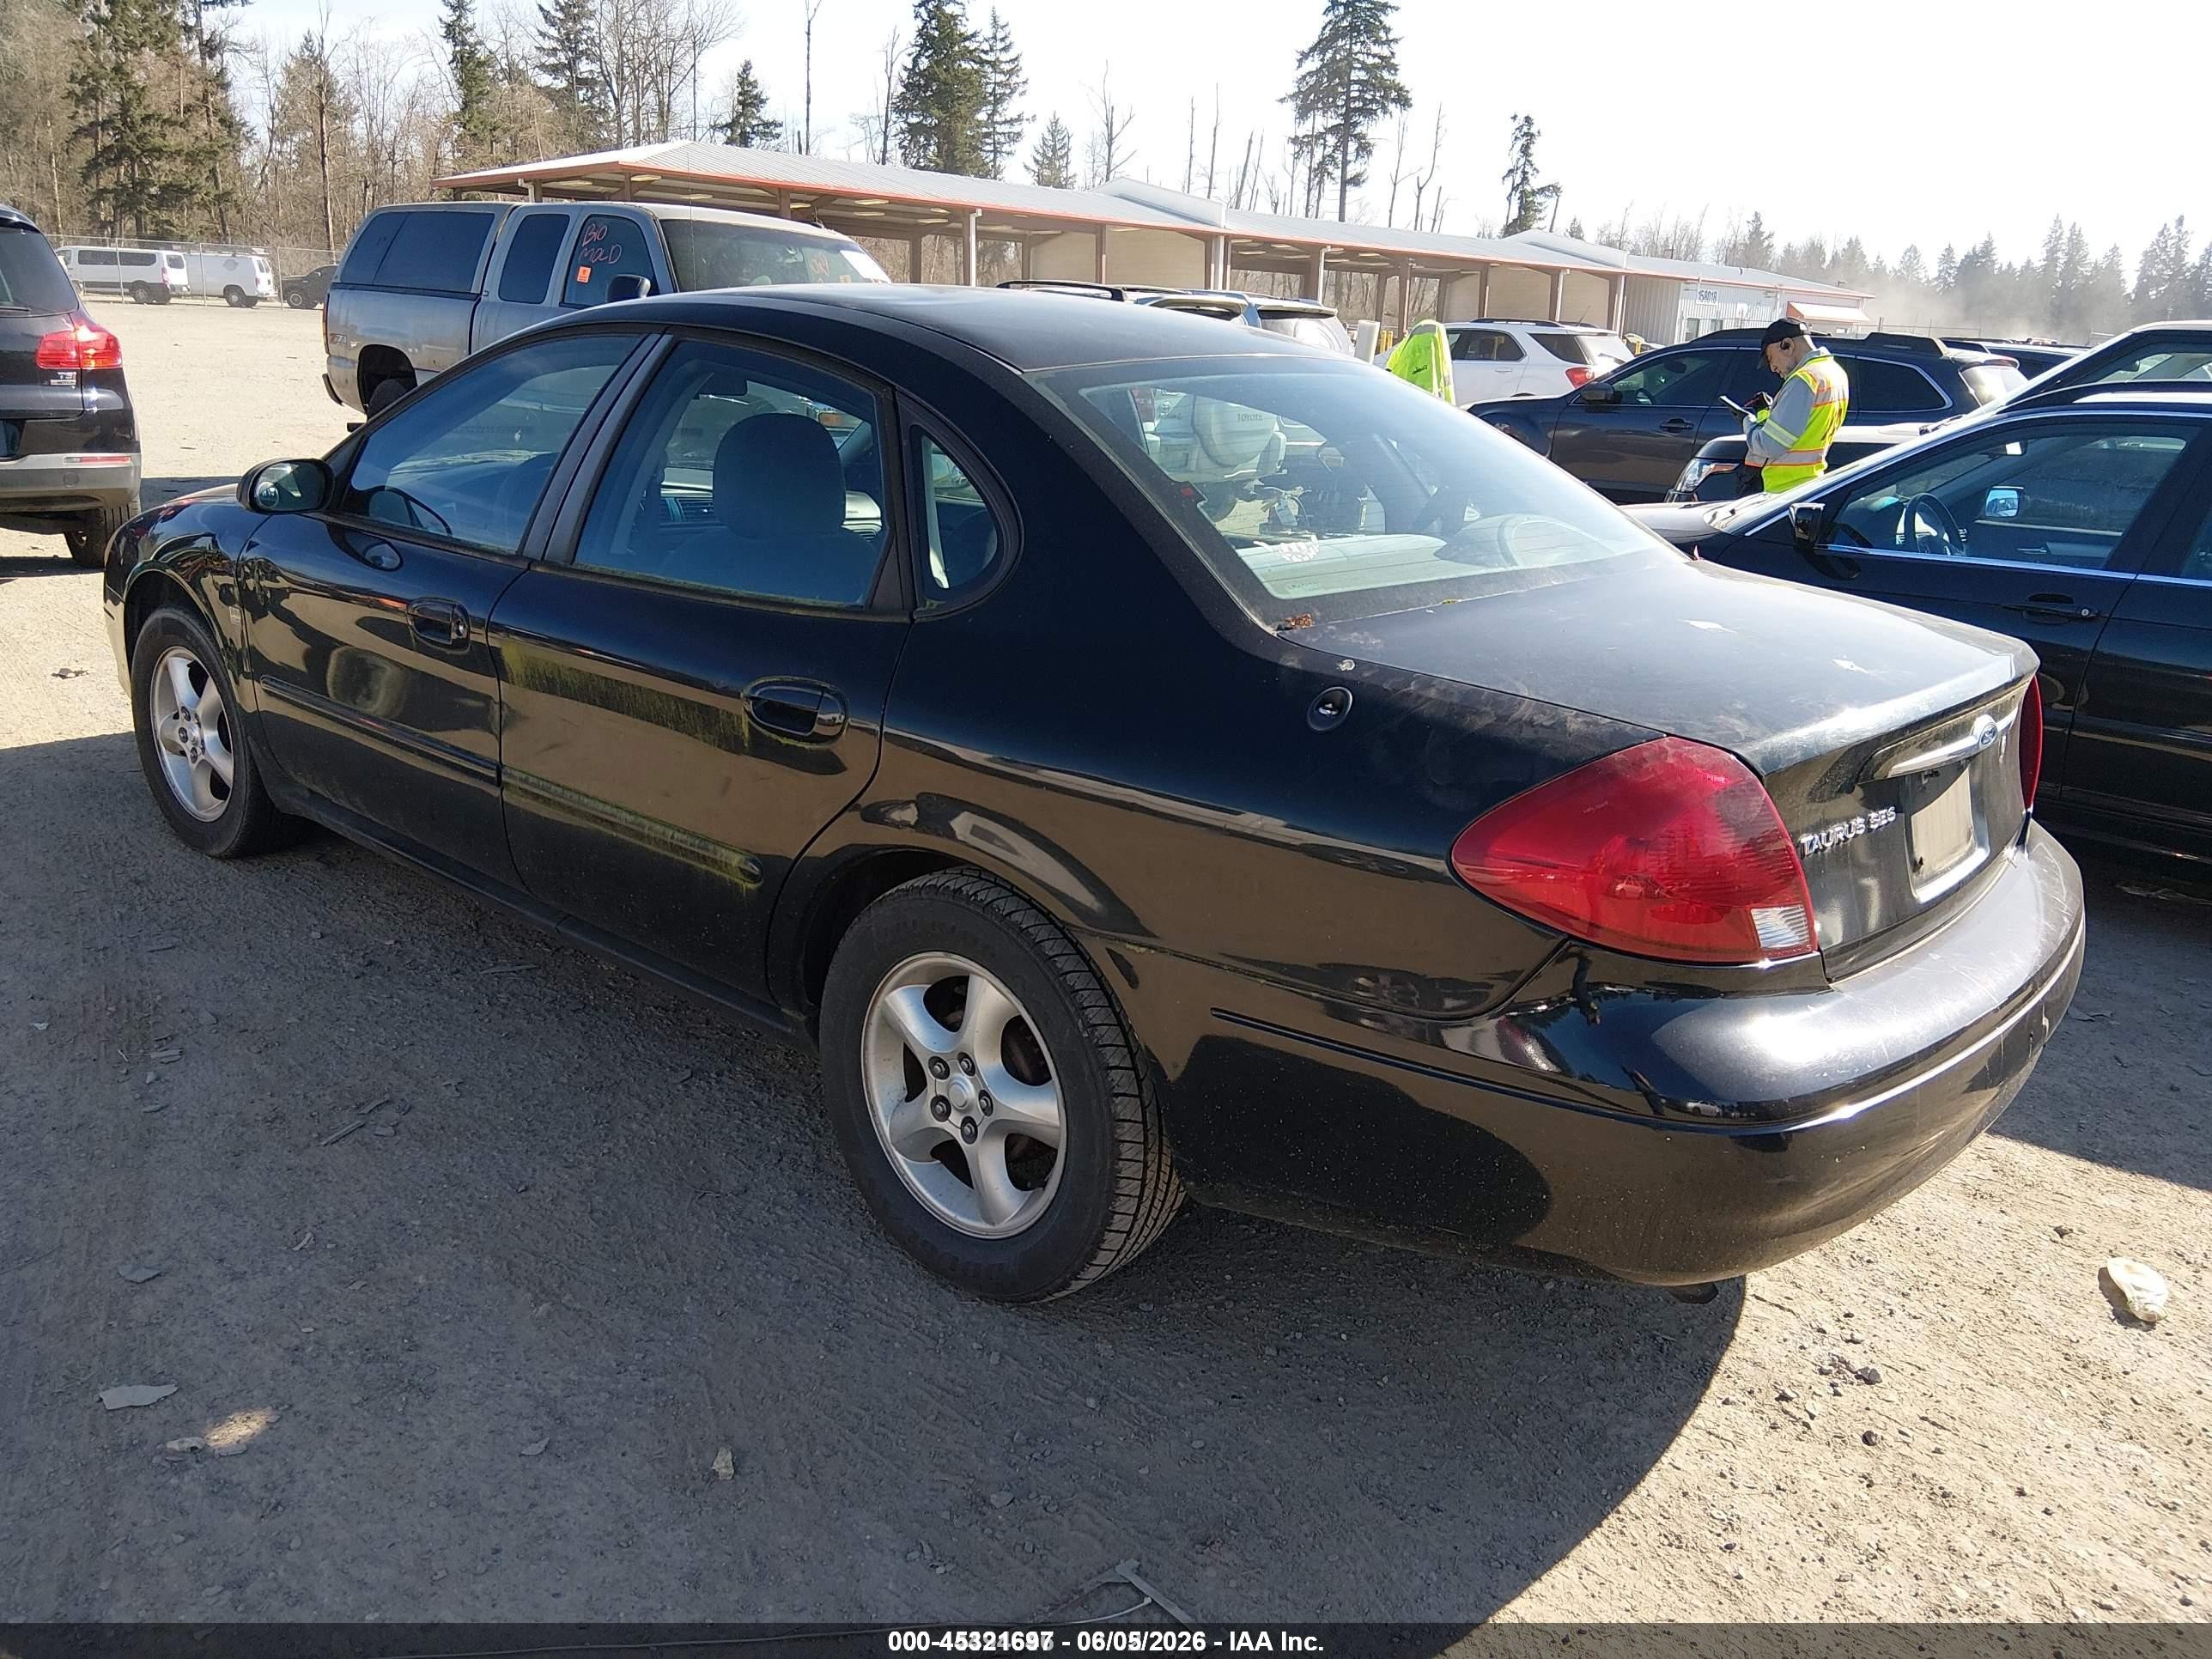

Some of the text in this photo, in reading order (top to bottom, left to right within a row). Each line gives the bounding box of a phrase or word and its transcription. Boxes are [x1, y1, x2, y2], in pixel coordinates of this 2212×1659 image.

[1237, 412, 1264, 422] TOYOTA
[1799, 805, 1897, 857] TAURUS SES
